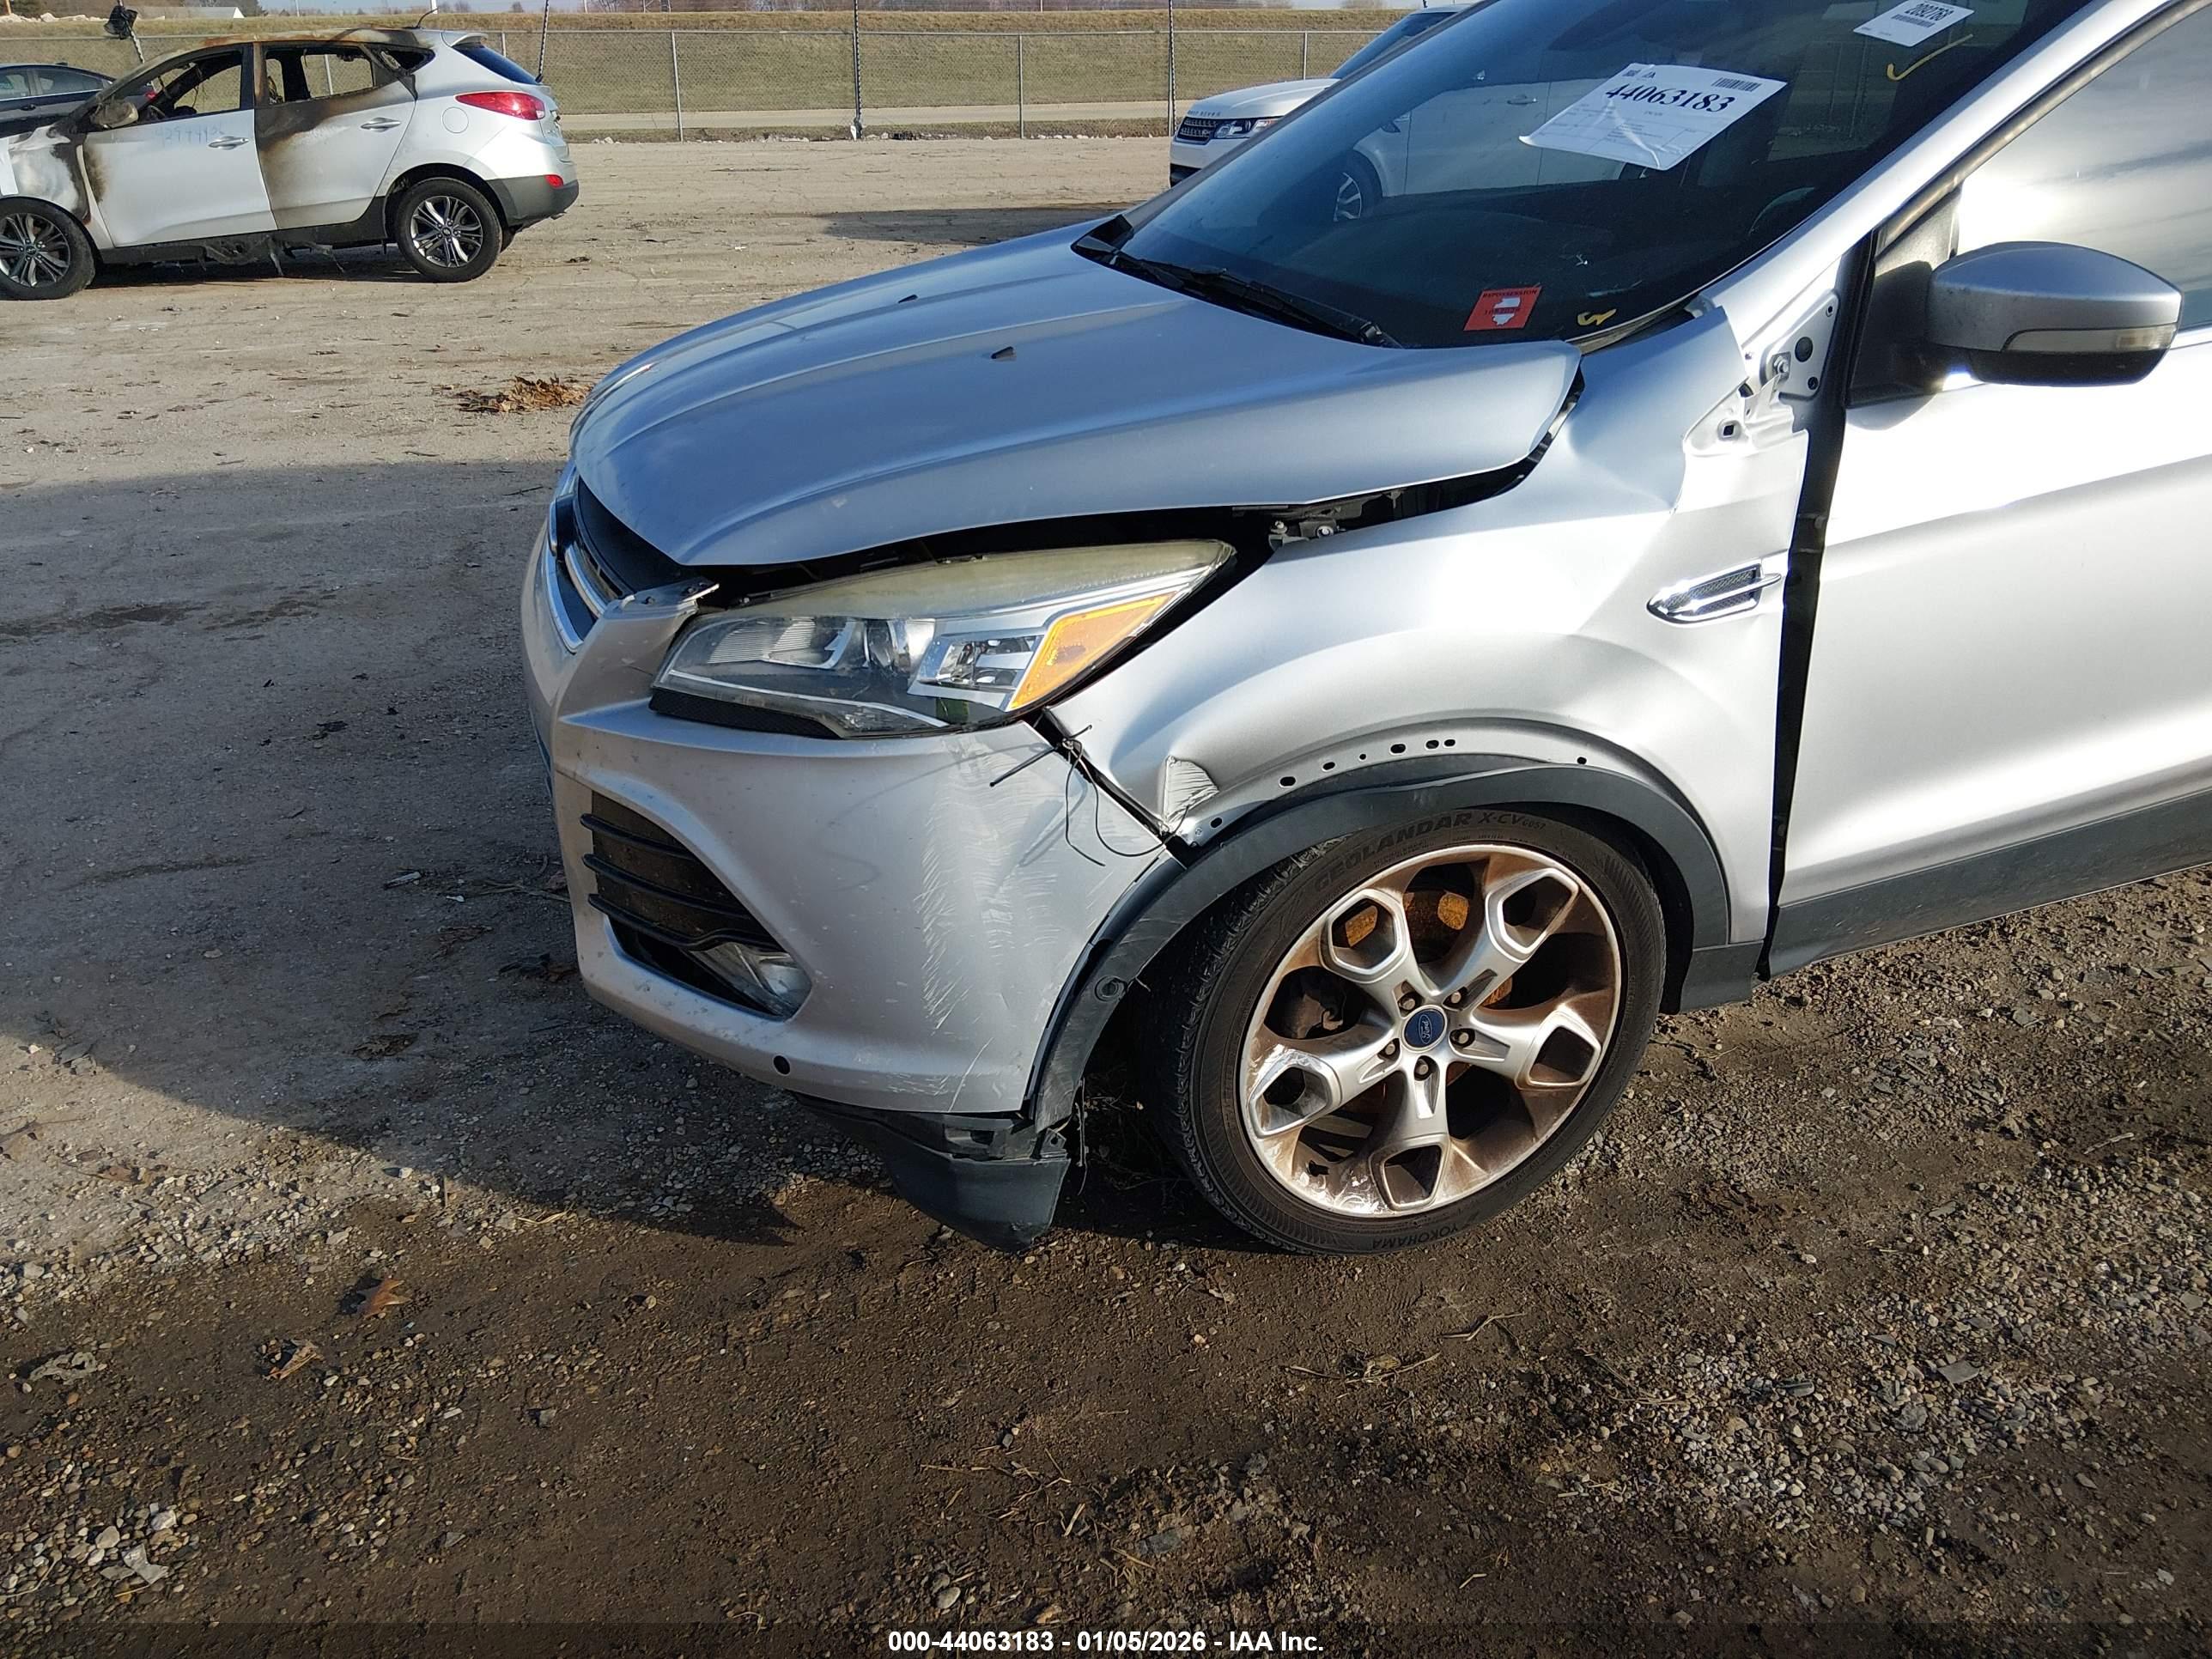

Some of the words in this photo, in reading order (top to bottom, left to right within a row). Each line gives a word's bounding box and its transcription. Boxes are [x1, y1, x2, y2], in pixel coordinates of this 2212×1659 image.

[1605, 82, 1735, 113] 44063183
[1314, 810, 1473, 890] GEOLANDAR
[1372, 1223, 1459, 1248] YOKOHAMA
